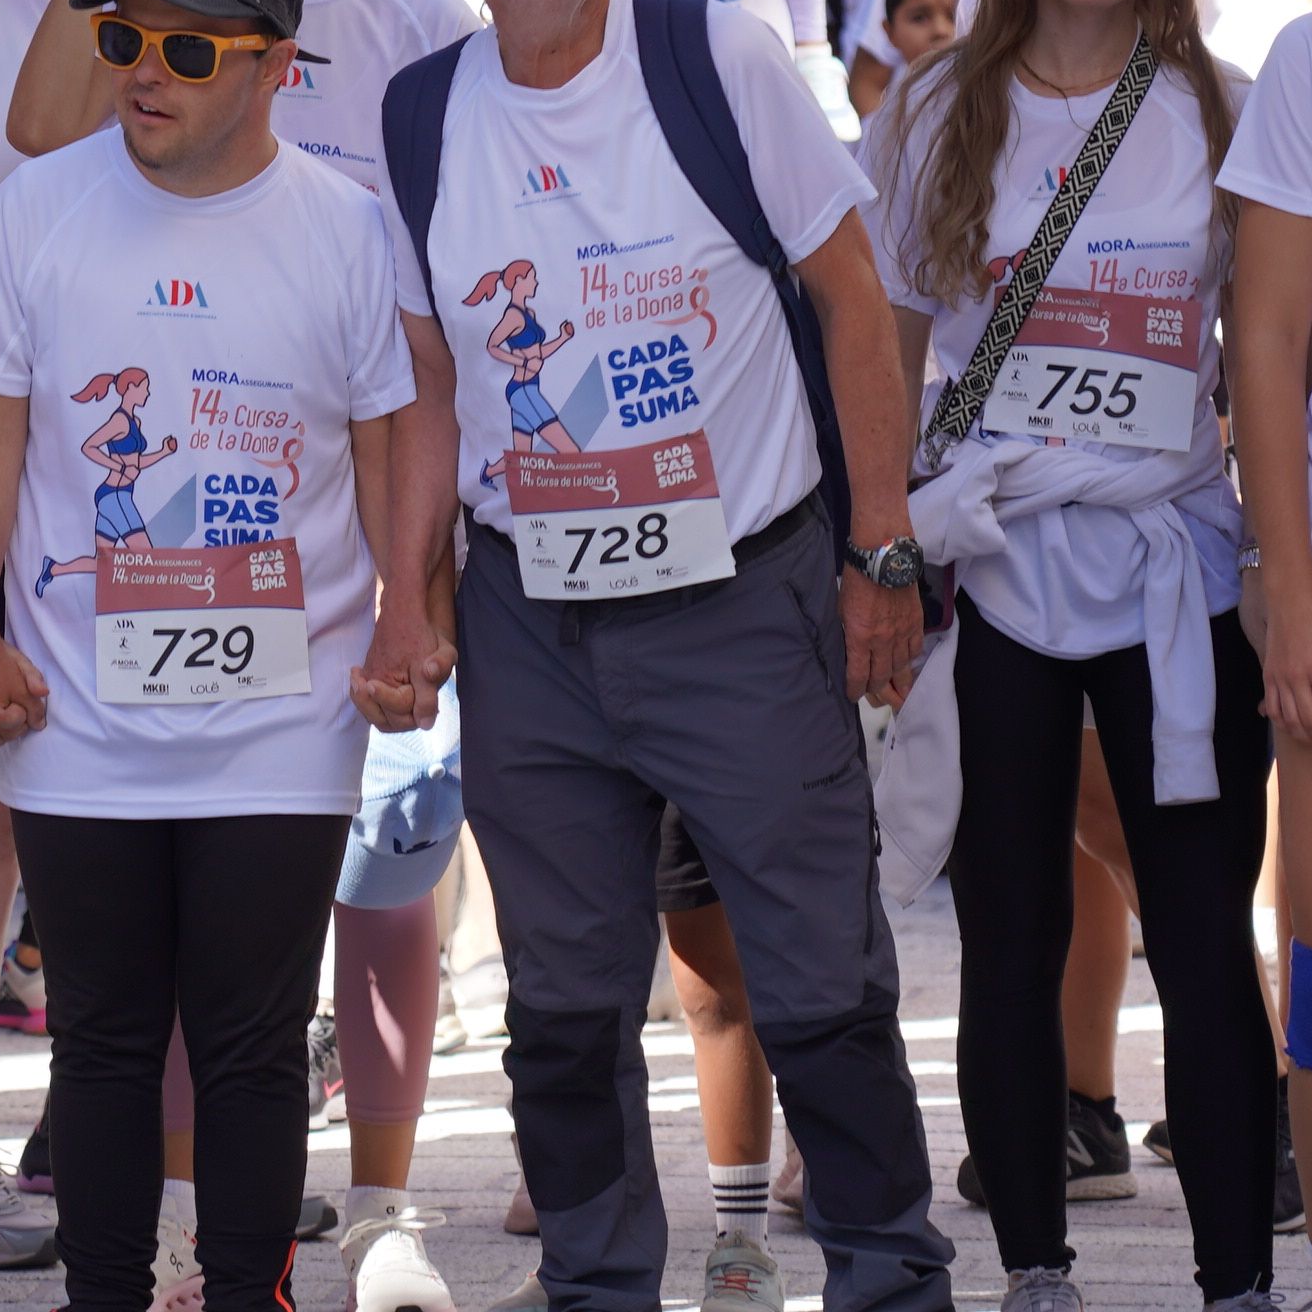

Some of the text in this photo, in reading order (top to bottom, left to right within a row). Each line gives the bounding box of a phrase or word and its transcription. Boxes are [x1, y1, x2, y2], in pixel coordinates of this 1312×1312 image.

[298, 141, 341, 158] MORA
[522, 163, 572, 196] ADA
[577, 241, 618, 261] MORA
[1088, 238, 1190, 255] MORA ASSEGURANCES
[624, 264, 683, 296] Cursa
[1134, 268, 1188, 290] Cursa
[146, 279, 208, 308] ADA
[585, 292, 684, 329] de la Dona
[1030, 308, 1054, 321] Cursa
[1055, 311, 1066, 321] de
[1078, 313, 1099, 326] Dona
[1147, 307, 1183, 321] CADA
[1147, 320, 1183, 334] PAS
[1146, 334, 1182, 348] SUMA
[608, 334, 688, 371] CADA
[191, 369, 294, 390] MORA ASSEGURANCES
[611, 357, 694, 401] PAS
[1037, 363, 1143, 419] 755
[234, 405, 289, 429] Cursa
[619, 386, 700, 427] SUMA
[190, 429, 279, 454] de la Dona
[519, 456, 556, 470] MORA
[653, 443, 692, 463] CADA
[655, 455, 695, 476] PAS
[204, 474, 279, 497] CADA
[658, 470, 698, 489] SUMA
[204, 499, 280, 524] PAS
[564, 512, 669, 575] 728
[113, 553, 154, 566] MORA
[248, 548, 285, 564] CADA
[249, 562, 286, 578] PAS
[251, 575, 288, 591] SUMA
[149, 624, 255, 678] 729
